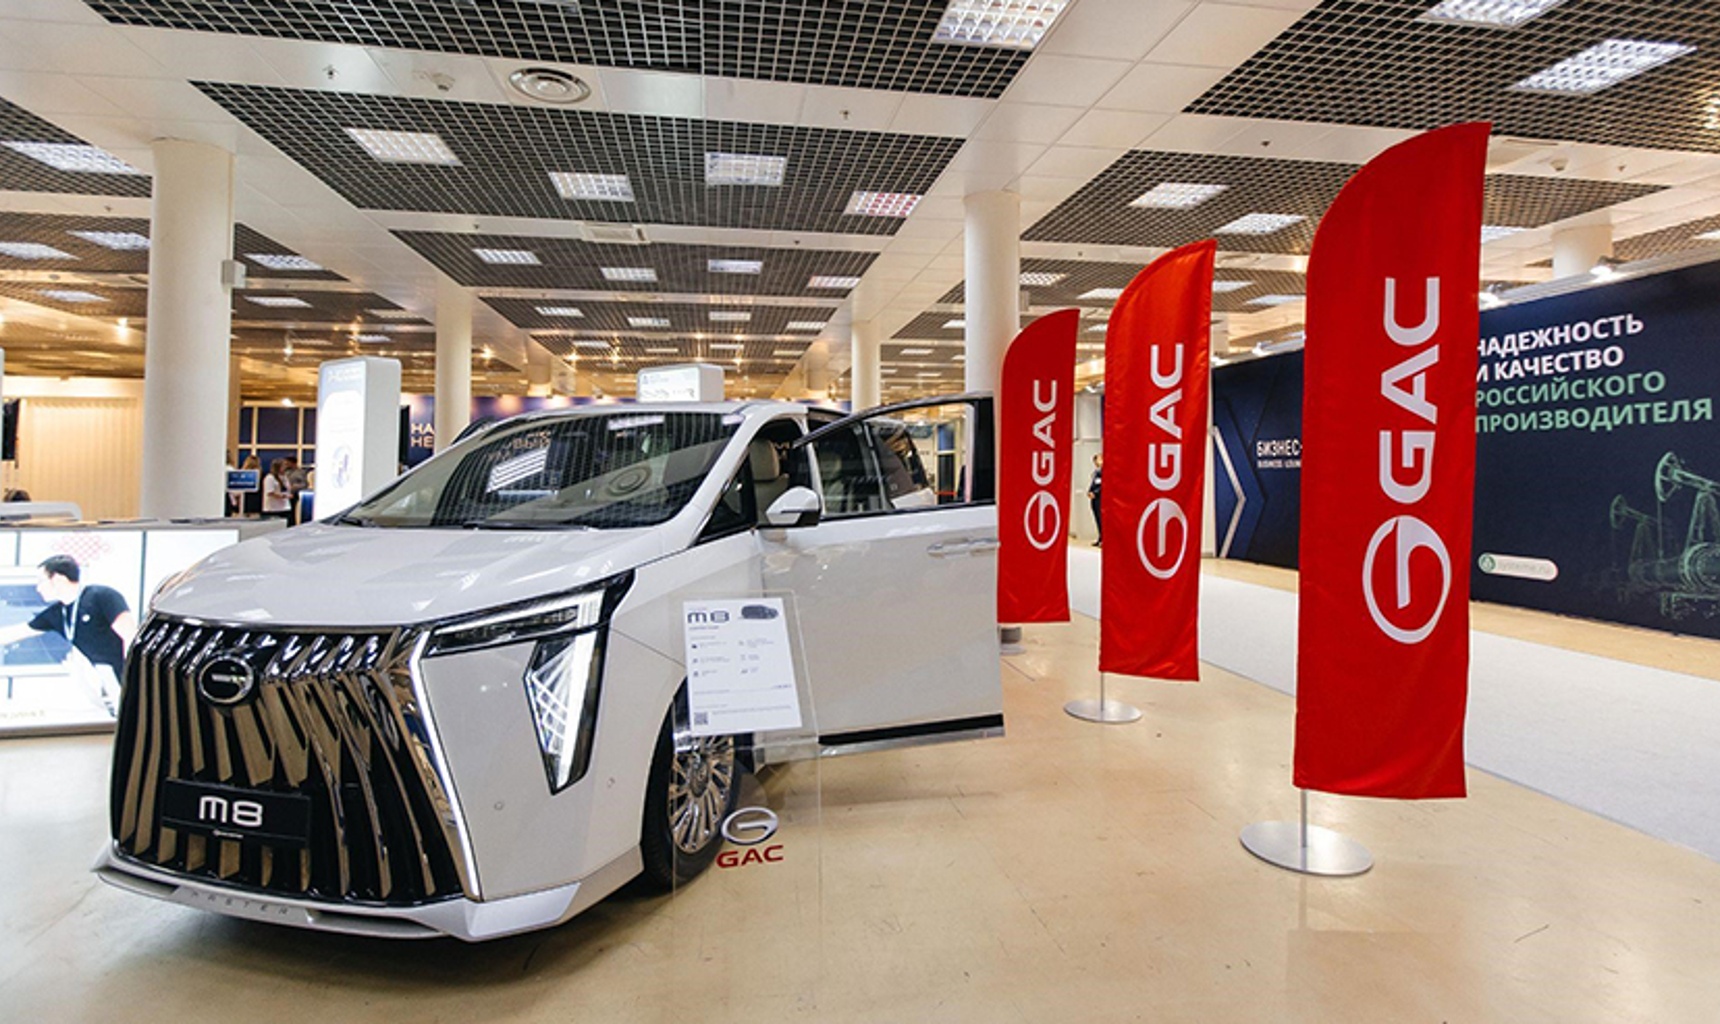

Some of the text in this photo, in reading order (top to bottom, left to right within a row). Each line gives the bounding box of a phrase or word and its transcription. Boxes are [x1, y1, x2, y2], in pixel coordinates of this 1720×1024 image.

[1494, 345, 1625, 381] КАЧЕСТВО
[1378, 277, 1440, 504] GAC
[1475, 370, 1666, 408] РОССИЙСКОГО
[1032, 380, 1057, 486] GAC
[1148, 343, 1184, 491] GAC
[1475, 397, 1713, 434] ПРОИЗВОДИТЕЛЯ
[716, 845, 784, 868] GAC
